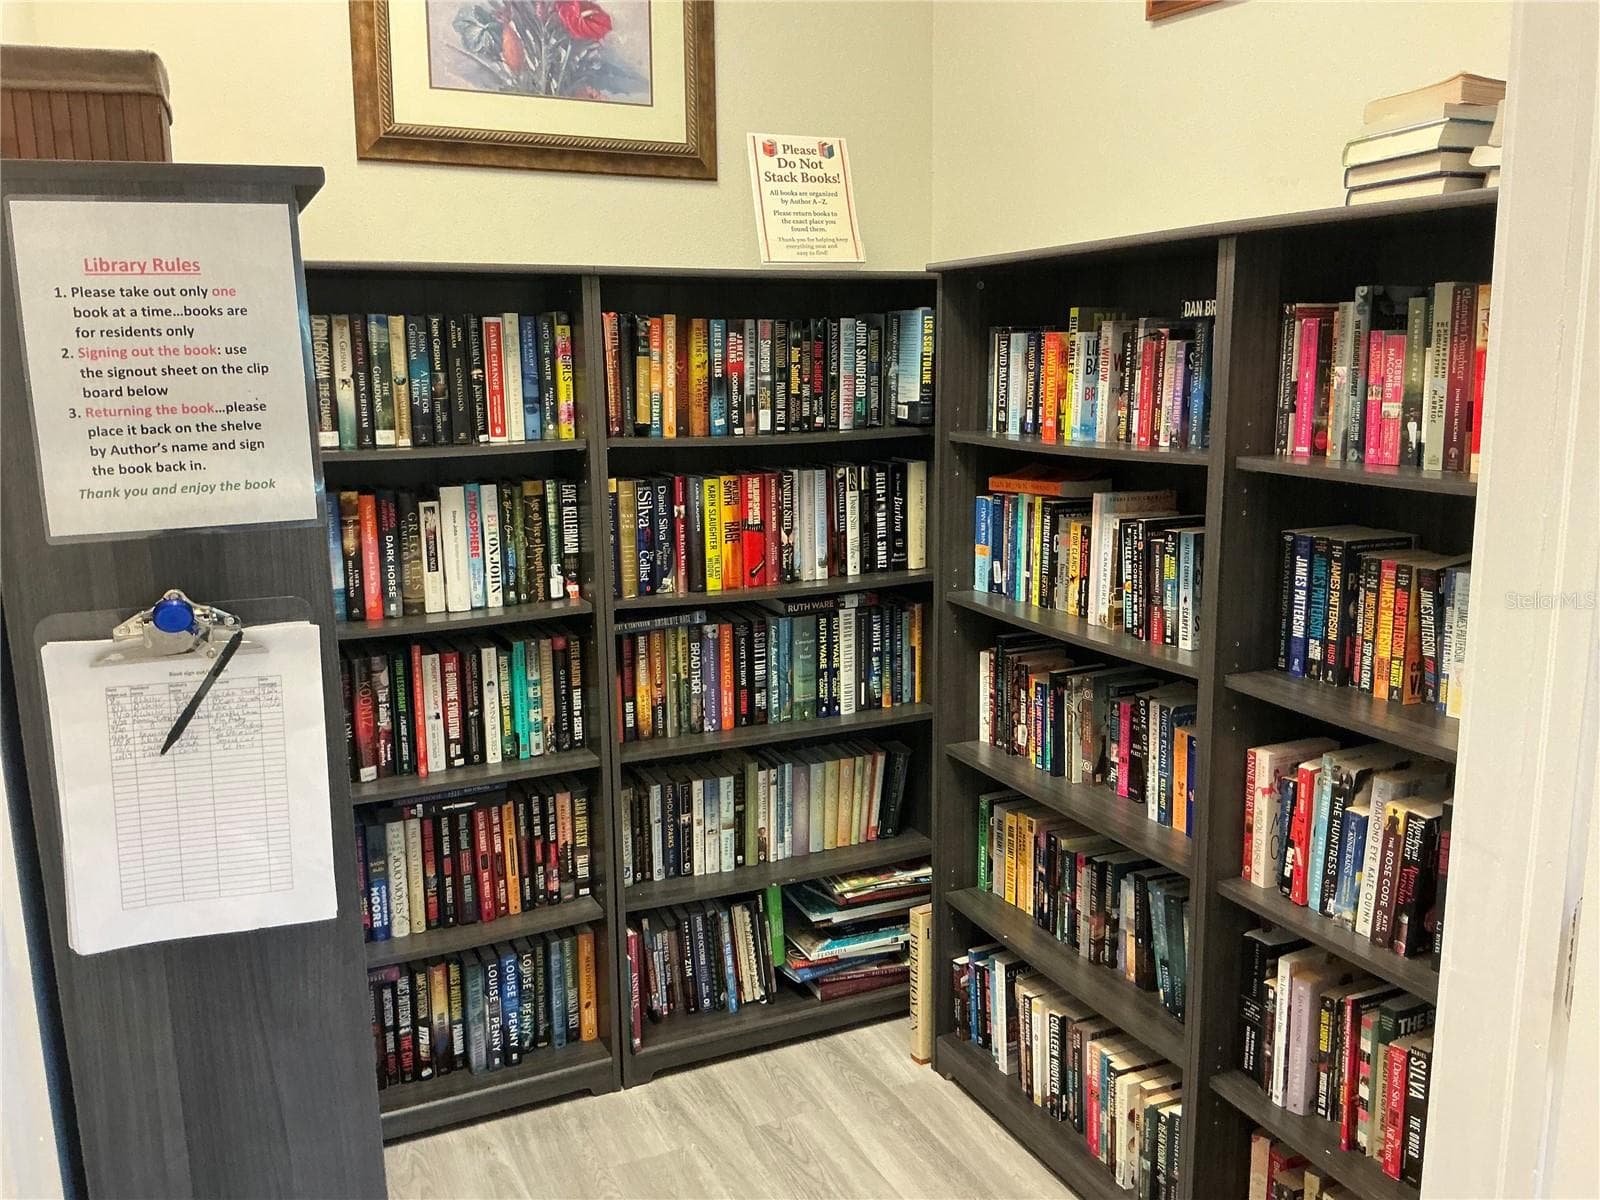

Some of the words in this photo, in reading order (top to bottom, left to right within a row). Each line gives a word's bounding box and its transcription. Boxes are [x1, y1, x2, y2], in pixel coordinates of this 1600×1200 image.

[782, 144, 817, 155] Please
[764, 171, 798, 183] Stack
[801, 173, 841, 184] Books!
[777, 158, 796, 169] Do
[800, 158, 824, 170] Not
[84, 257, 147, 274] Library
[153, 257, 201, 273] Rules
[55, 287, 66, 298] 1.
[71, 286, 115, 298] Please
[120, 286, 148, 297] take
[153, 286, 176, 297] out
[180, 285, 208, 299] only
[212, 287, 236, 297] one
[73, 306, 108, 318] book
[112, 308, 126, 317] at
[130, 309, 137, 317] a
[227, 307, 247, 316] are
[1184, 301, 1202, 317] DAN
[75, 327, 96, 338] for
[100, 326, 162, 337] residents
[166, 325, 194, 339] only
[489, 326, 498, 352] GAME
[714, 323, 722, 347] JAMES
[855, 320, 866, 346] JOHN
[924, 316, 933, 334] LISA
[1069, 316, 1078, 339] BILL
[62, 348, 74, 359] 2.
[78, 347, 127, 360] Signing
[132, 347, 154, 357] out
[158, 346, 179, 357] the
[184, 345, 221, 356] book:
[225, 345, 247, 355] use
[714, 349, 722, 378] ROLLINS
[922, 336, 934, 385] SCOTTOLINE
[998, 340, 1007, 366] DAVID
[1067, 340, 1076, 375] BAILEY
[80, 367, 103, 379] the
[107, 366, 157, 379] signout
[161, 364, 198, 377] sheet
[201, 365, 217, 375] on
[222, 363, 243, 375] the
[247, 362, 269, 376] clip
[491, 353, 500, 390] CHANGE
[561, 354, 572, 382] GIRLS
[855, 349, 867, 397] SANDFORD
[1385, 348, 1395, 399] MACOMBER
[1394, 359, 1403, 388] DEBBIE
[83, 386, 123, 398] board
[127, 386, 168, 397] below
[372, 366, 382, 413] GUARDIANS
[998, 367, 1008, 407] BALDACCI
[69, 408, 81, 419] 3.
[85, 406, 152, 419] Returning
[156, 405, 177, 416] the
[88, 426, 123, 440] place
[127, 424, 137, 435] it
[140, 423, 171, 435] back
[175, 424, 192, 433] on
[195, 422, 217, 433] the
[221, 420, 262, 432] shelve
[90, 445, 106, 458] by
[110, 442, 168, 456] Author's
[172, 443, 208, 453] name
[212, 439, 236, 451] and
[239, 439, 265, 452] sign
[92, 465, 114, 476] the
[119, 463, 152, 475] book
[156, 461, 186, 472] back
[190, 461, 206, 471] in.
[79, 487, 120, 500] Thank
[124, 488, 148, 499] you
[152, 485, 177, 496] and
[181, 482, 216, 496] enjoy
[220, 481, 241, 492] the
[245, 478, 276, 490] book
[561, 484, 577, 504] FAYE
[637, 490, 653, 529] Silva
[467, 490, 480, 559] ATMOSPHERE
[487, 514, 498, 555] ELTON
[563, 506, 579, 554] KELLERMAN
[709, 510, 718, 550] SLAUGHTER
[724, 522, 740, 544] RAGE
[876, 512, 886, 539] DANIEL
[385, 535, 396, 563] DARK
[877, 541, 887, 568] SUAREZ
[489, 556, 501, 594] JOHN
[639, 550, 651, 582] Cellist
[1295, 556, 1309, 587] JAMES
[1330, 559, 1341, 591] JAMES
[387, 565, 397, 598] HORSE
[787, 603, 811, 613] RUTH
[812, 600, 834, 609] WARE
[1292, 589, 1307, 638] PATTERSON
[1327, 591, 1341, 641] PATTERSON
[444, 662, 454, 672] THE
[690, 642, 700, 669] BRAD
[1327, 644, 1336, 665] HUSH
[445, 672, 457, 701] BOURNE
[691, 671, 701, 695] THOR
[446, 702, 460, 739] EVOLUTION
[1160, 709, 1168, 738] VINCE
[1246, 753, 1255, 782] ANNE
[1246, 783, 1255, 813] PERRY
[1333, 796, 1344, 818] THE
[1327, 820, 1342, 876] HUNTRESS
[1387, 837, 1395, 849] THE
[1382, 850, 1394, 878] ROSE
[1379, 878, 1391, 908] CODE
[371, 886, 383, 929] MOORE
[487, 964, 498, 1003] LOUISE
[505, 959, 516, 998] LOUISE
[490, 1017, 501, 1052] PENNY
[508, 1012, 519, 1047] PENNY
[1050, 1016, 1060, 1057] COLLEEN
[1050, 1058, 1060, 1095] HOOVER
[1409, 1057, 1427, 1100] SILVA
[1410, 1114, 1422, 1133] THE
[1408, 1133, 1421, 1158] ORDER
